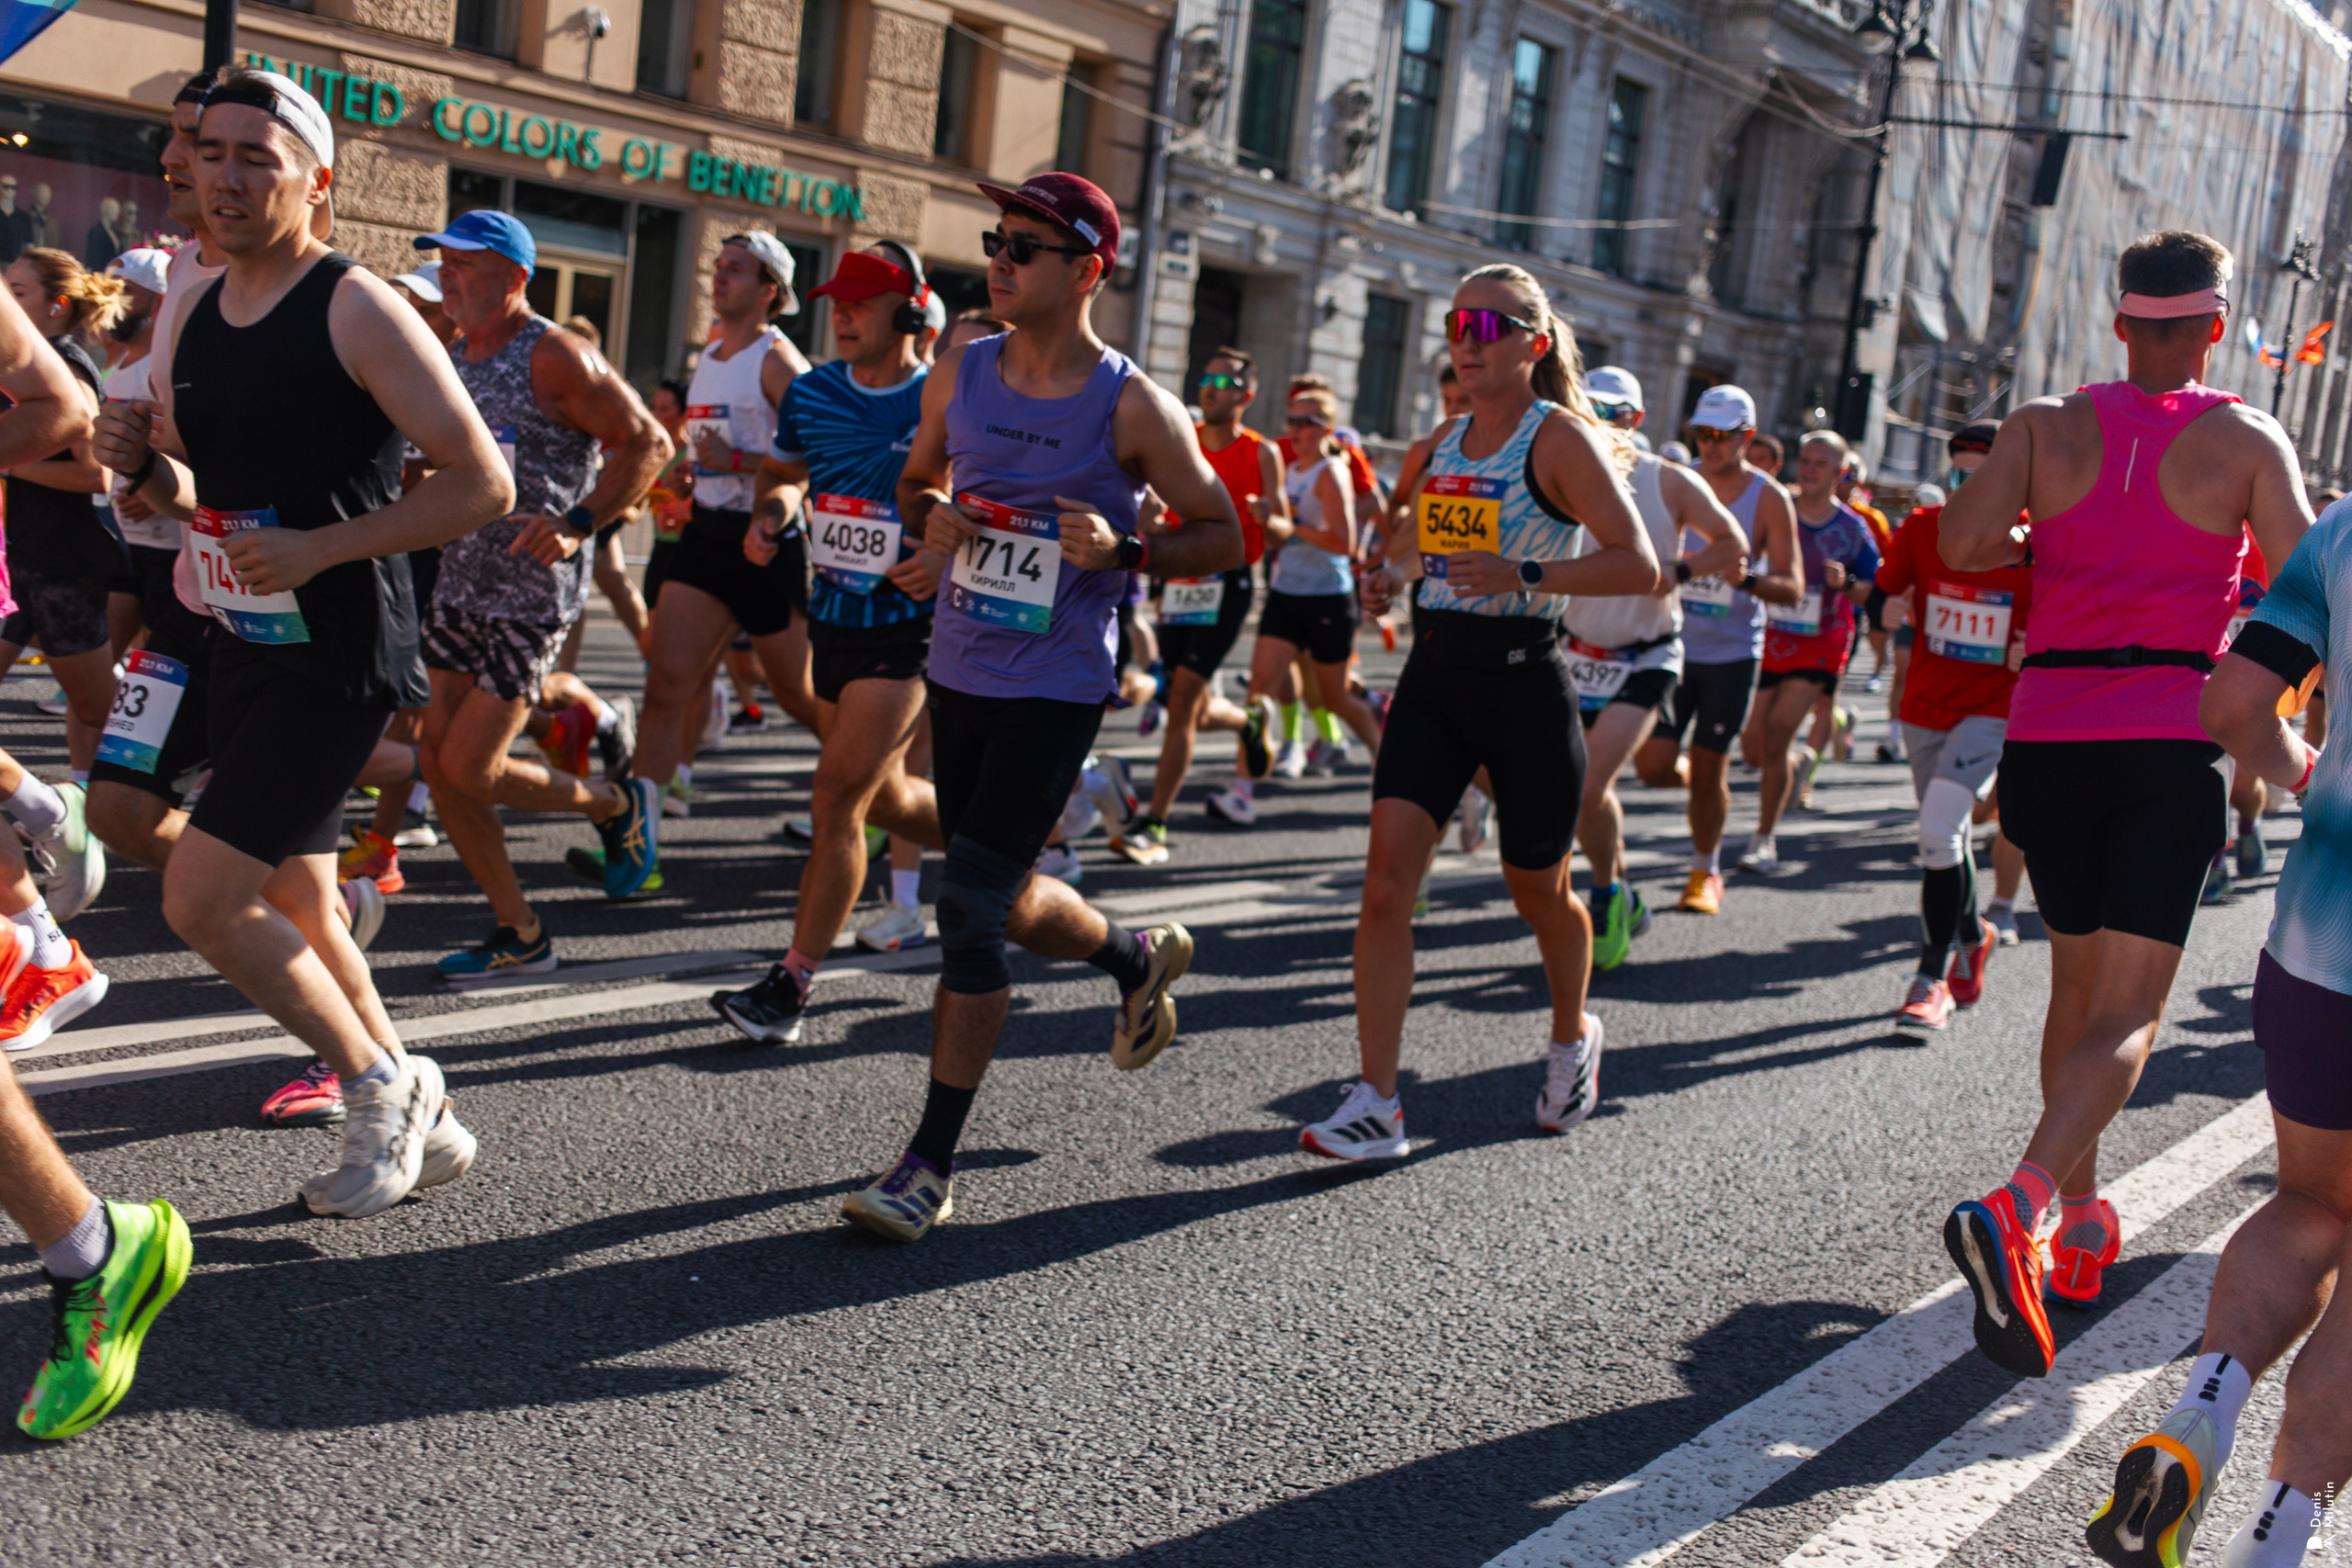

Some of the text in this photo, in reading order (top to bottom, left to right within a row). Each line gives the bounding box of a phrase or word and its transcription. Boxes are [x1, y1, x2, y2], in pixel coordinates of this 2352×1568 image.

[248, 52, 404, 127] ITED
[433, 96, 605, 172] COLORS
[621, 138, 676, 183] OF
[986, 423, 1063, 450] UNDER BY ME
[821, 521, 887, 558] 4038
[1427, 502, 1487, 541] 5434
[966, 535, 1043, 582] 1714
[970, 573, 1016, 593] КИРИЛЛ
[1936, 605, 1996, 639] 7111
